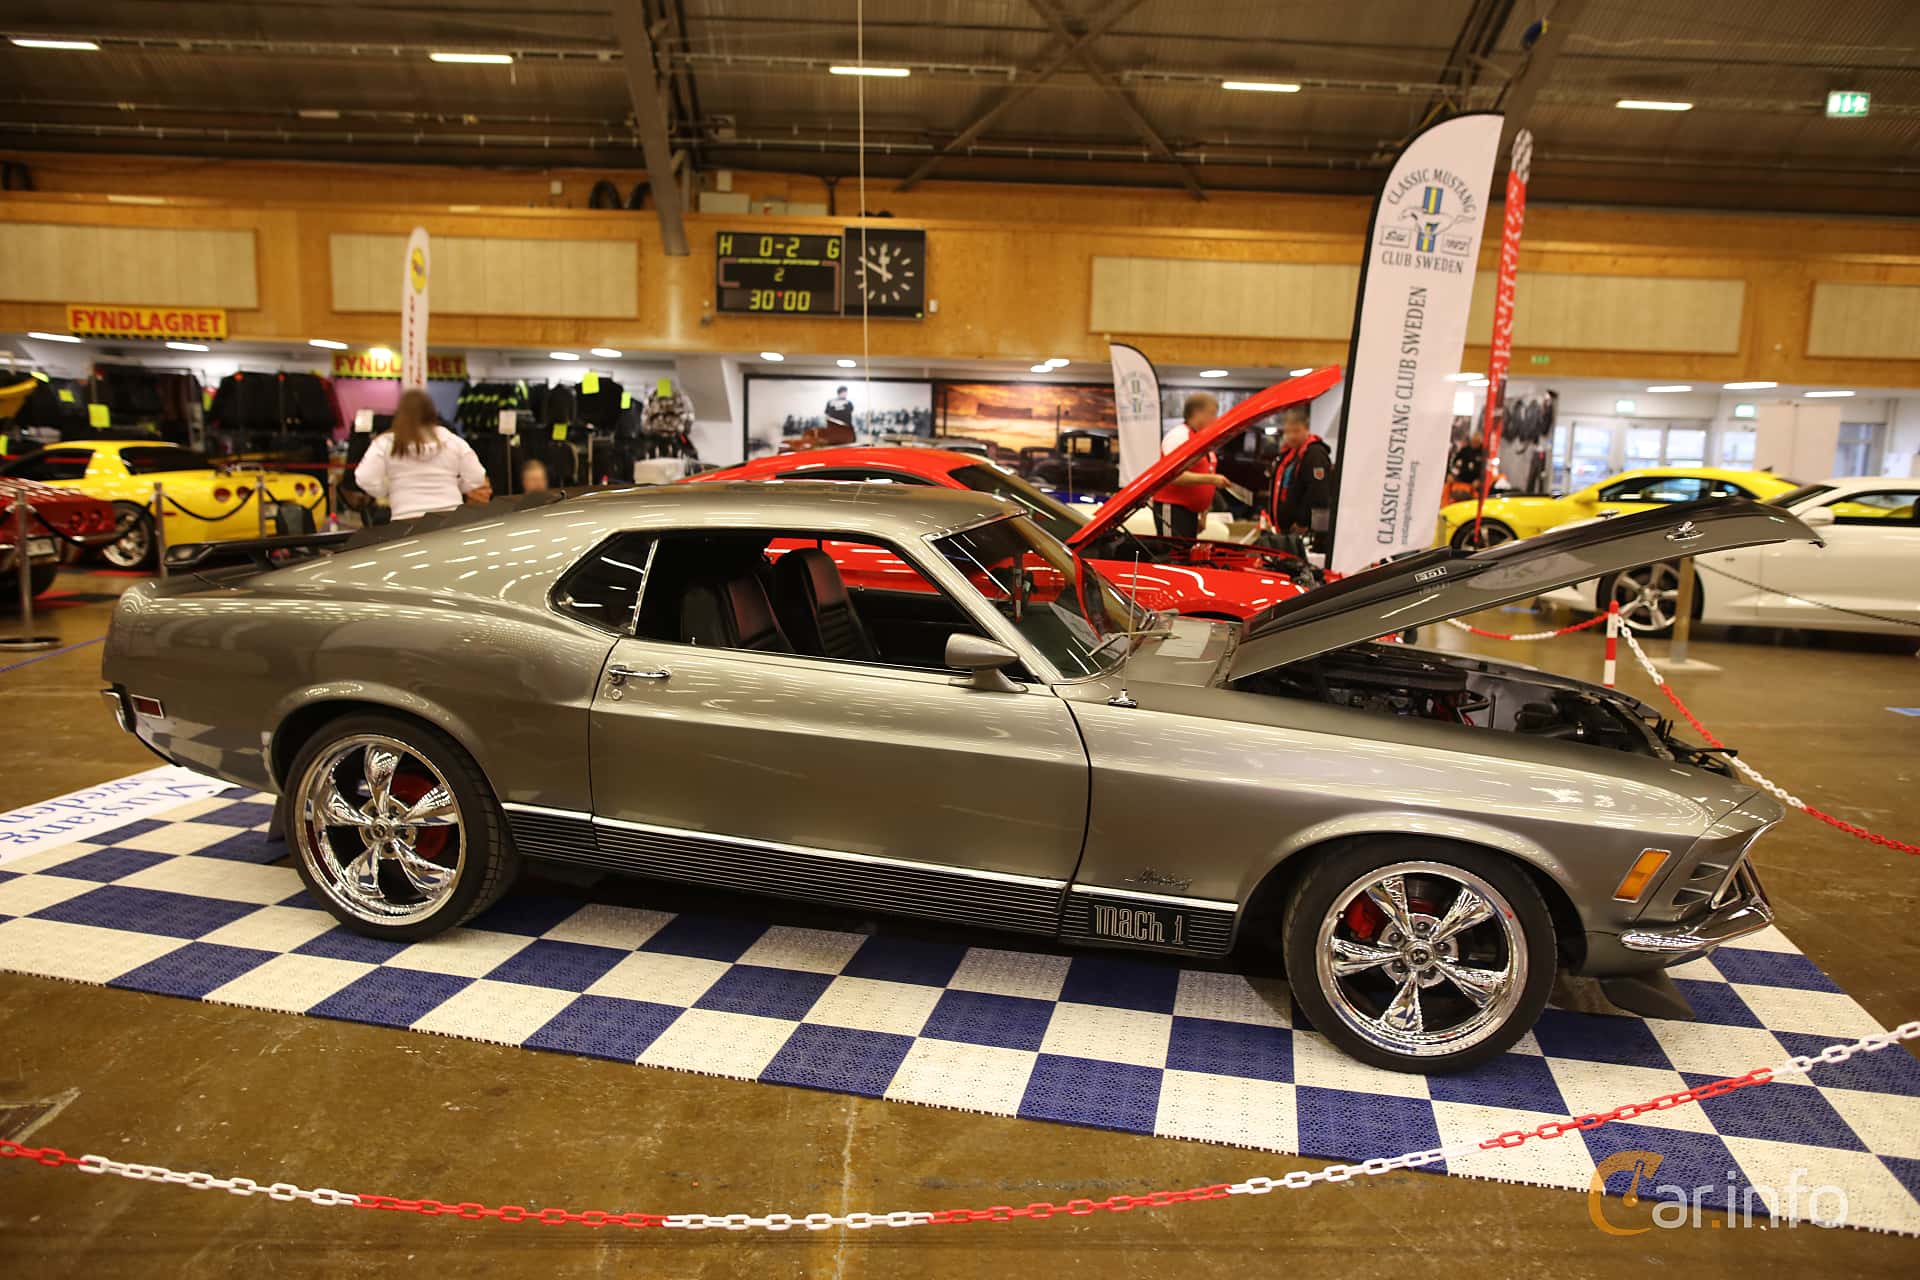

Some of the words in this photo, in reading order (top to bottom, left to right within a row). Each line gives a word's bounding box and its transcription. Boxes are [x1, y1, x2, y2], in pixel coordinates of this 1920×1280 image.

[1387, 168, 1429, 205] CLASSIC
[1432, 168, 1477, 214] MUSTANG
[719, 235, 733, 255] H
[759, 236, 800, 258] 0-2
[827, 238, 840, 259] G
[1382, 250, 1411, 266] CLUB
[1415, 255, 1463, 274] SWEDEN
[774, 267, 785, 282] 2
[72, 309, 221, 332] FYNDLAGRET
[1401, 286, 1427, 356] SWEDEN
[335, 355, 466, 374] FYNDLRET
[1395, 359, 1417, 400] CLUB
[1385, 404, 1411, 480] MUSTANG
[1377, 482, 1401, 544] CLASSIC
[1172, 914, 1184, 945] 1
